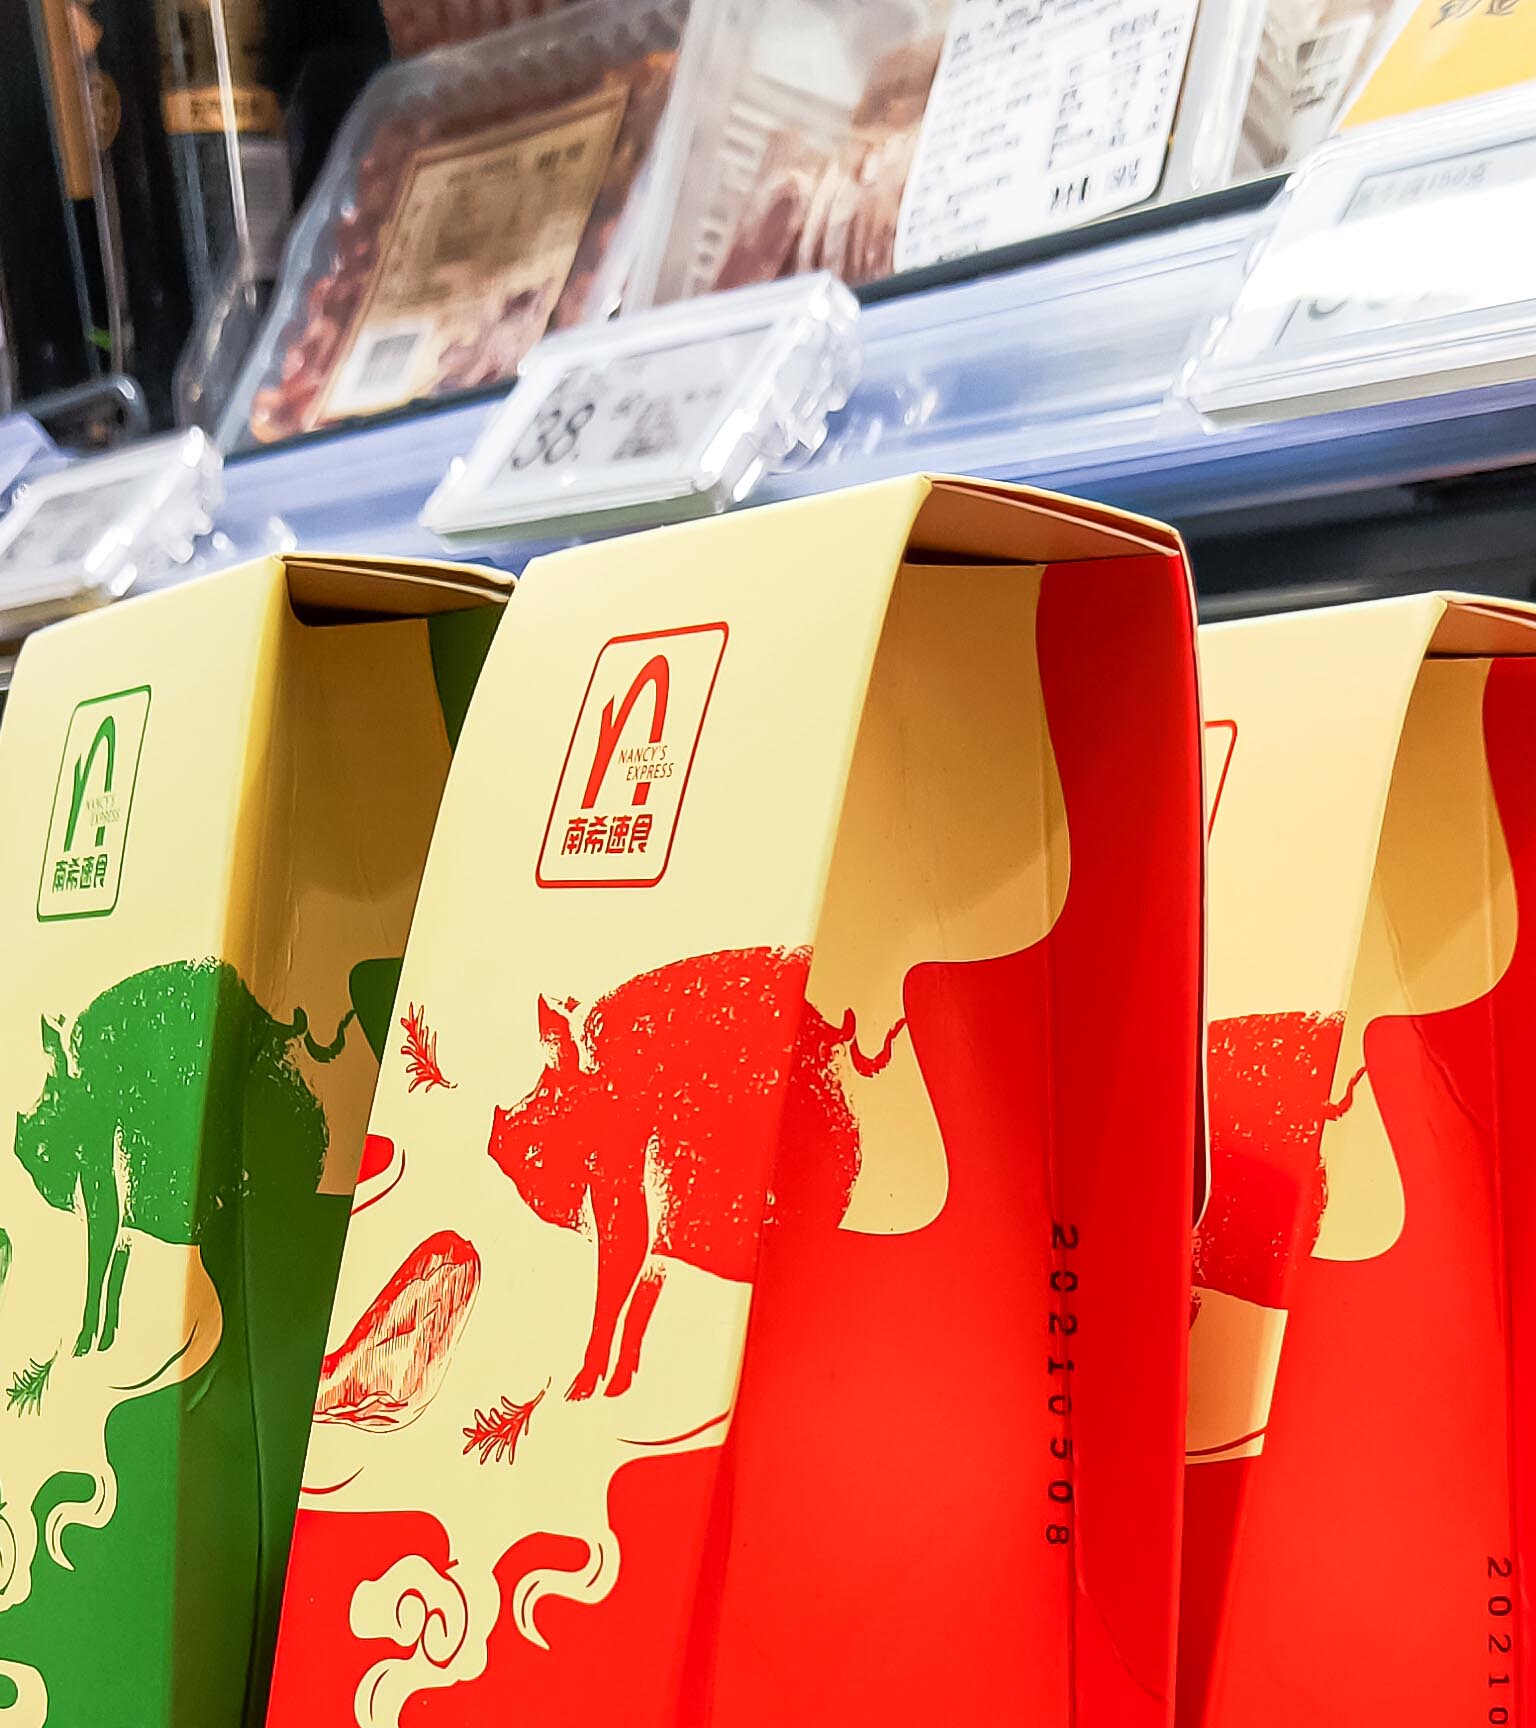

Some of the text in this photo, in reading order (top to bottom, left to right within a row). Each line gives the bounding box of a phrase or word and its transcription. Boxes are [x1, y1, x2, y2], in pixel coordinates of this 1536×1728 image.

[617, 745, 669, 765] NANCY'S
[626, 762, 675, 782] EXPRESS
[561, 813, 653, 856] 南希速食
[1045, 1220, 1080, 1546] 20210508
